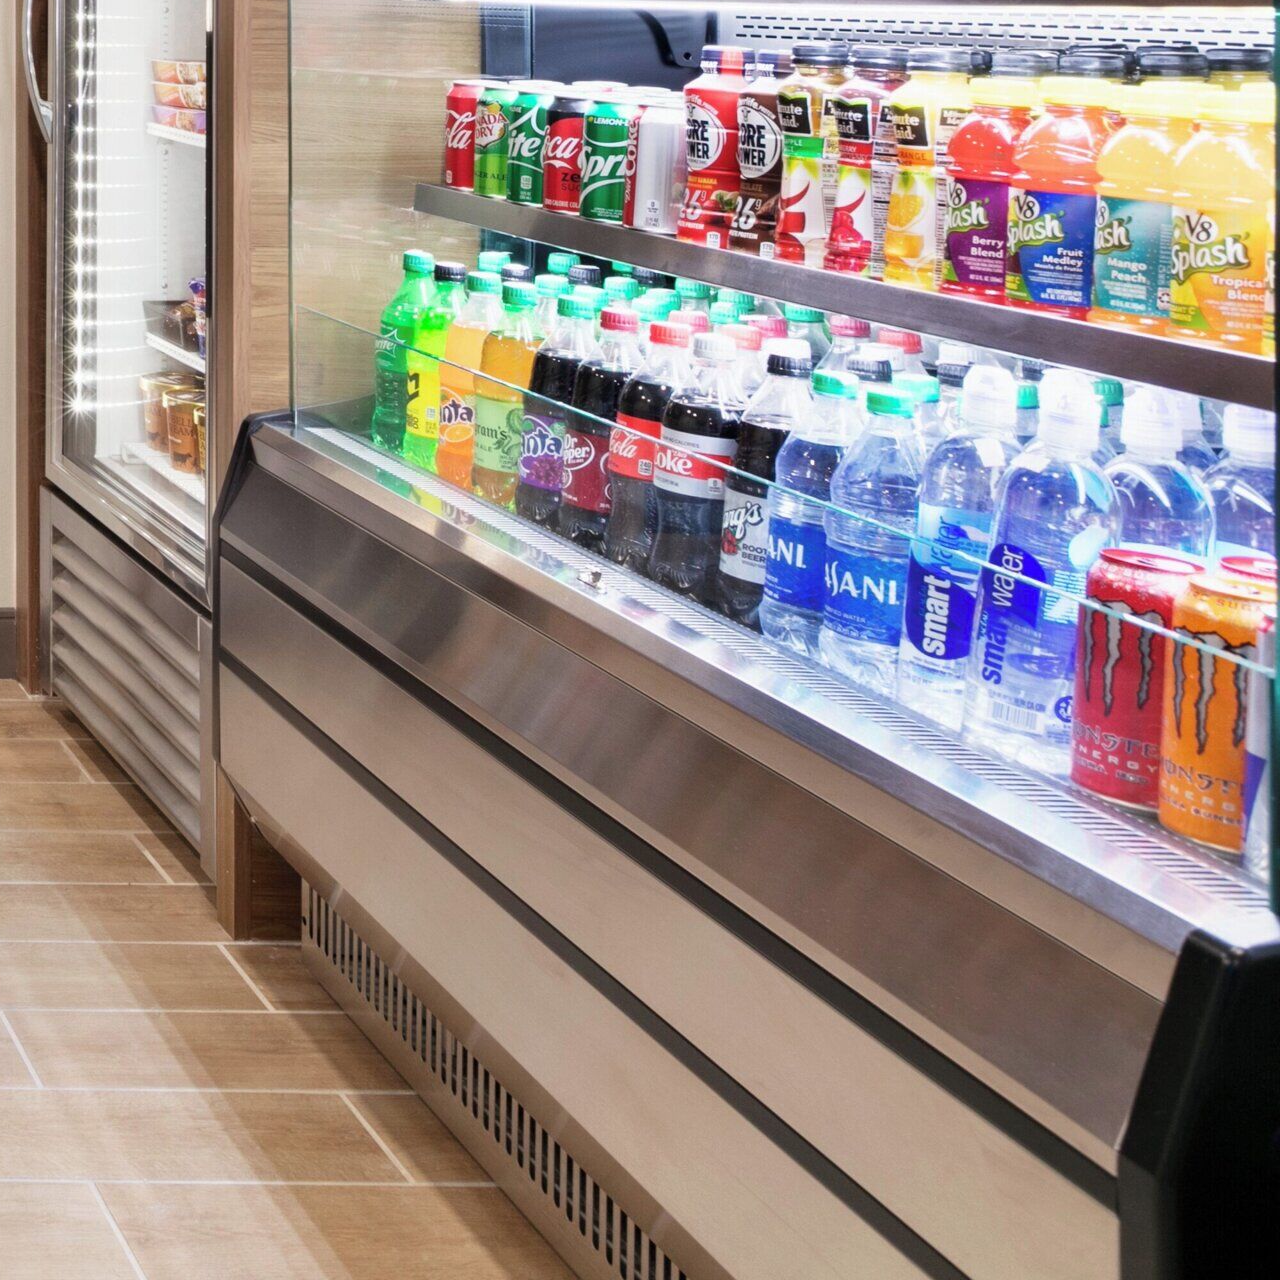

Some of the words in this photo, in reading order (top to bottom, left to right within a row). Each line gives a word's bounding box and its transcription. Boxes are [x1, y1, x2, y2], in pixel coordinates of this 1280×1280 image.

[1017, 194, 1036, 220] V8
[1185, 212, 1213, 243] V8
[972, 235, 1004, 249] Berry
[970, 247, 1004, 258] Blend
[1057, 247, 1083, 257] Fruit
[1171, 236, 1250, 282] Splash
[1042, 255, 1083, 267] Medley
[1107, 257, 1147, 271] Mango
[1111, 271, 1147, 282] Peach
[742, 553, 766, 563] BEER
[922, 574, 953, 657] smart
[982, 620, 1009, 685] smar
